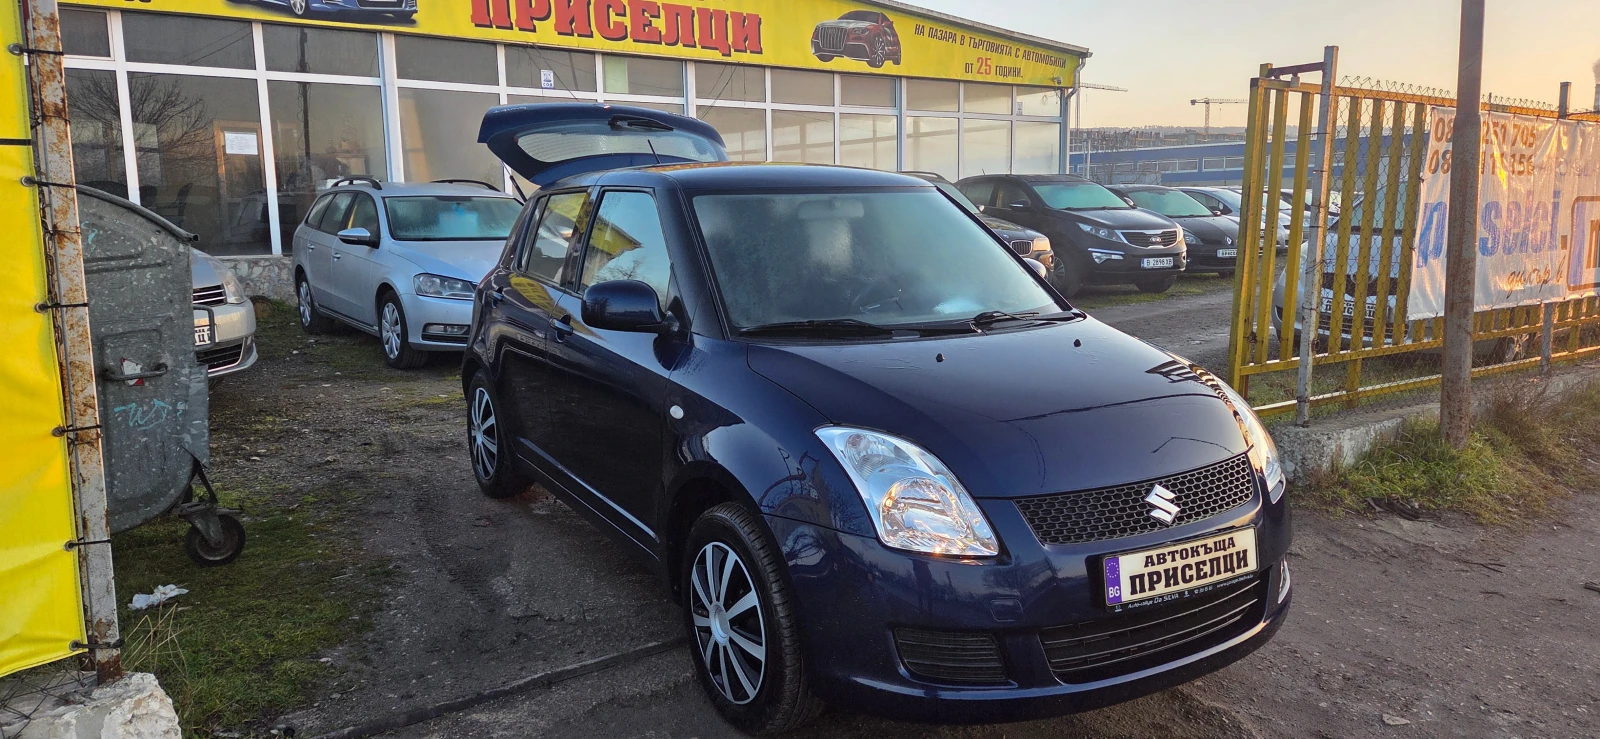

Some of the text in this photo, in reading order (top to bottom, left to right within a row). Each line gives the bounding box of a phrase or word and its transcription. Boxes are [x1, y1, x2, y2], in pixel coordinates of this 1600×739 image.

[471, 0, 763, 57] ПРИСЕЛЦИ
[914, 23, 1067, 69] НА ПАЗАРА В ТЪРГОВИЯТА С АВТОМОБИЛИ
[976, 56, 992, 76] 25
[1511, 123, 1536, 147] 705
[1143, 536, 1237, 568] АВТОКЪЩА
[1129, 549, 1249, 596] ПРИСЕЛЦИ
[1108, 586, 1121, 598] BG
